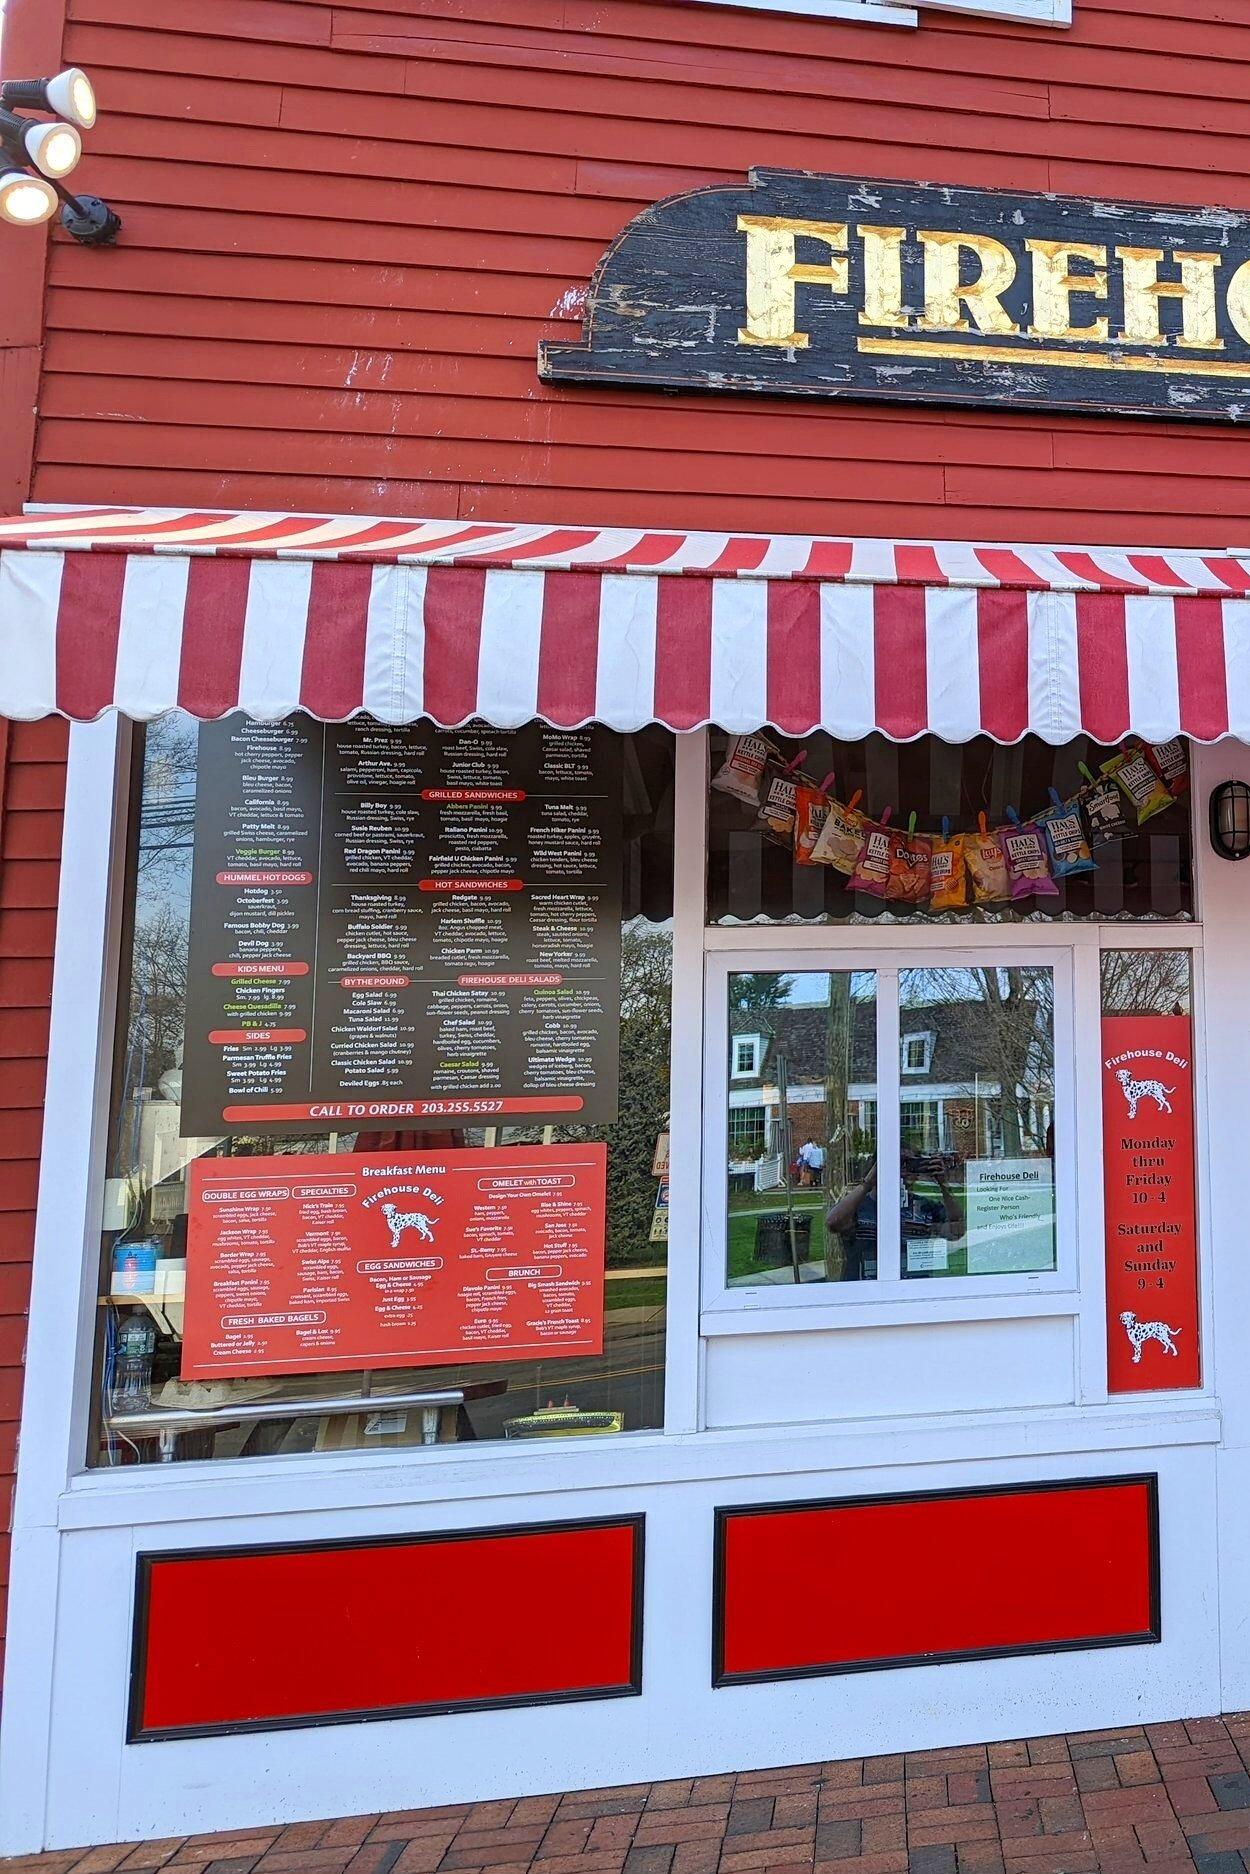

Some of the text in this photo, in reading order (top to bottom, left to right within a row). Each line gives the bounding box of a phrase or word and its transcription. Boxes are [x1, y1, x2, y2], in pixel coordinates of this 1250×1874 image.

[1011, 851, 1027, 859] KETTLE
[1104, 1048, 1189, 1070] Firehouse Deli
[310, 1100, 504, 1117] CALL TO ORDER 203.255.5527
[1120, 1137, 1176, 1152] Monday
[1133, 1155, 1165, 1168] thru
[362, 1165, 446, 1177] Breakfast Menu
[979, 1171, 1039, 1181] Firehouse Deli
[492, 1179, 523, 1187] OMELET
[1125, 1174, 1172, 1188] Friday
[204, 1192, 237, 1200] DOUBLE
[258, 1190, 288, 1198] WRAPS
[301, 1188, 349, 1196] SPECIALTIES
[361, 1184, 445, 1208] Firehouse Deli
[1132, 1192, 1148, 1203] 10
[1157, 1191, 1166, 1203] 4
[1019, 1213, 1041, 1221] Friendly
[1117, 1222, 1182, 1237] Saturday
[1136, 1241, 1164, 1253] and
[365, 1260, 436, 1270] EGG SANDWICHES
[1124, 1259, 1177, 1273] Sunday
[508, 1269, 541, 1277] BRUNCH
[1137, 1278, 1146, 1290] 9
[1155, 1277, 1165, 1289] 4
[228, 1314, 319, 1326] FRESH BAKED BAGELS
